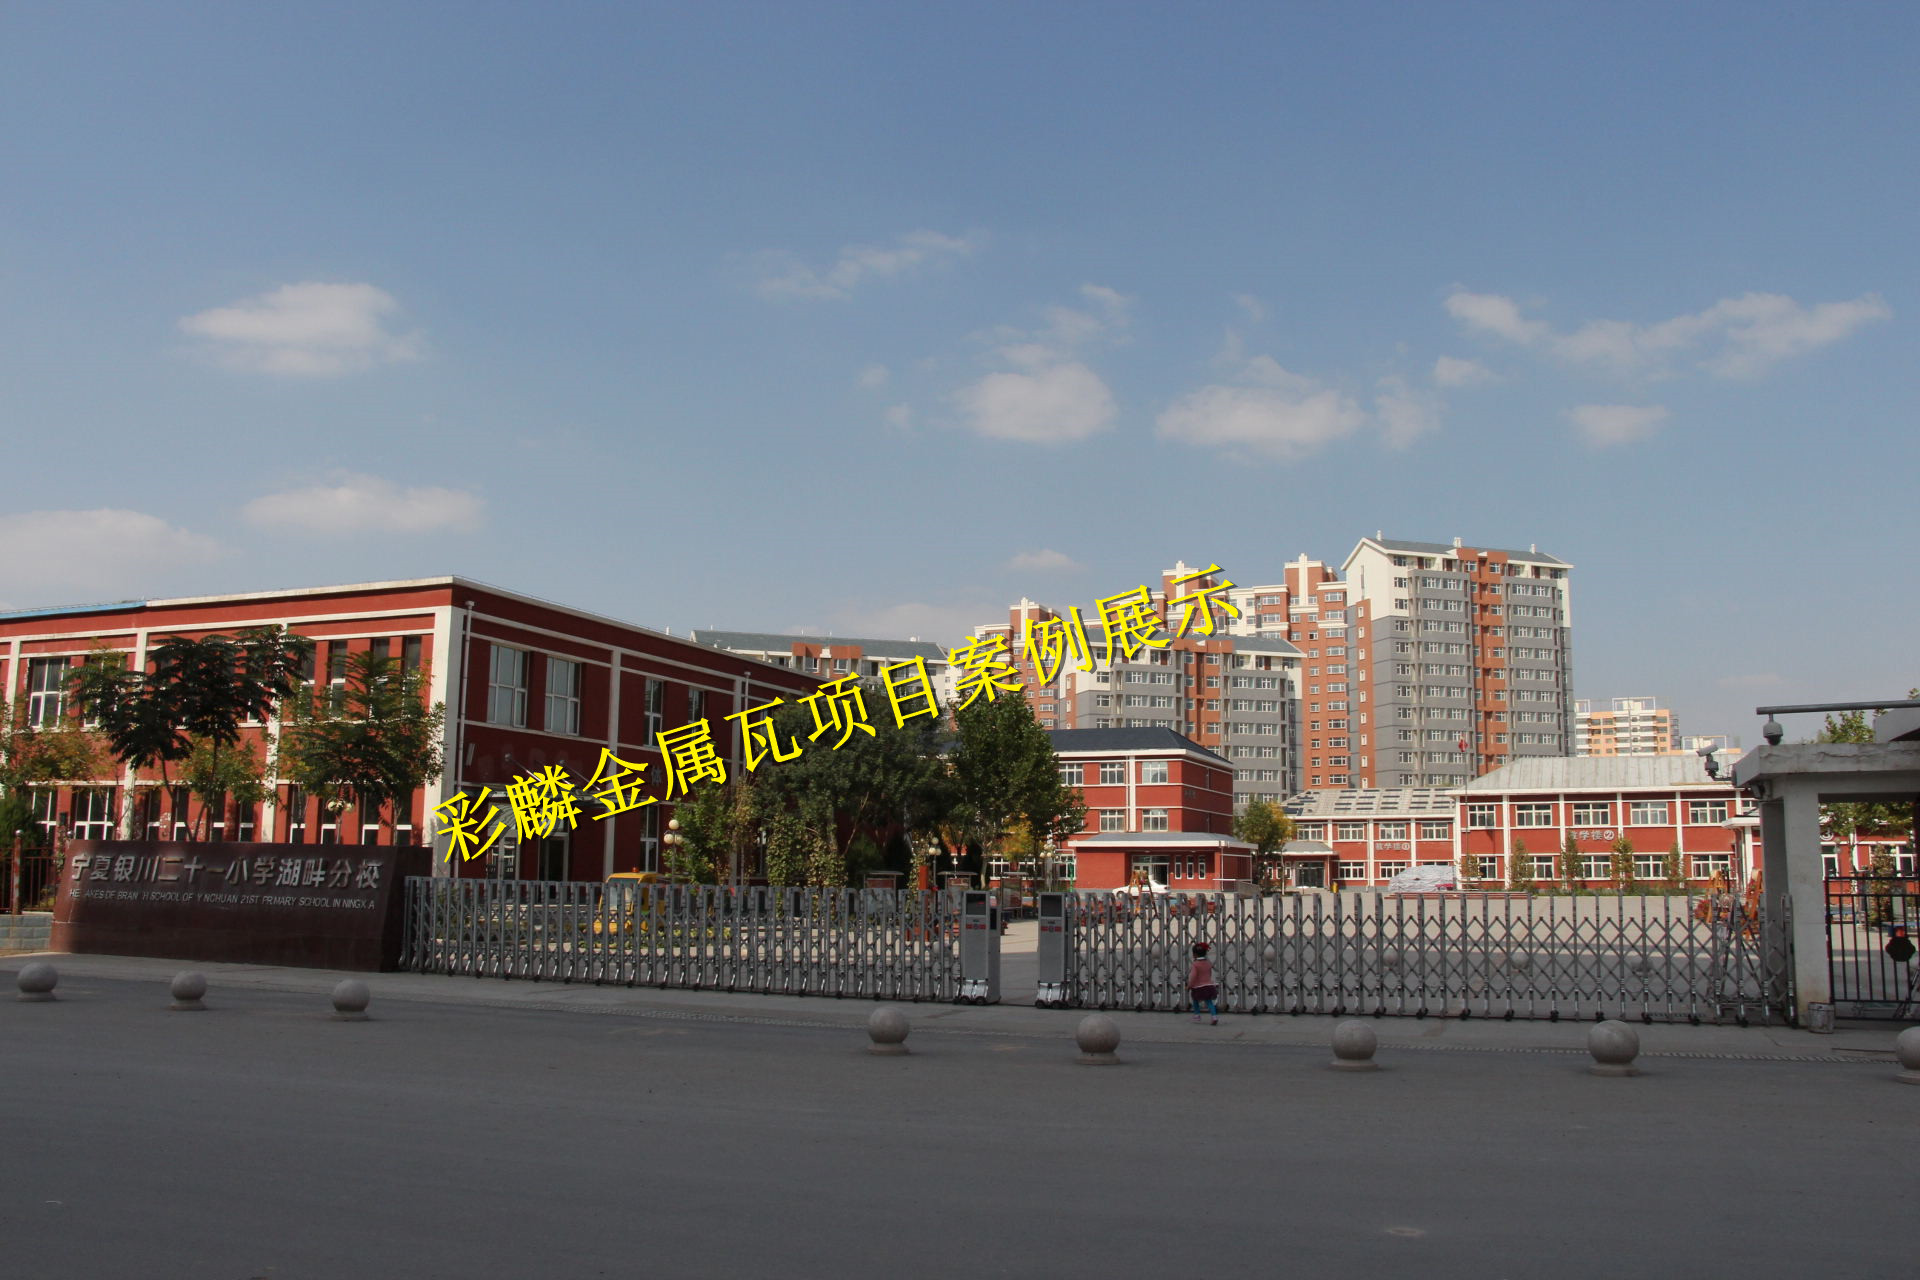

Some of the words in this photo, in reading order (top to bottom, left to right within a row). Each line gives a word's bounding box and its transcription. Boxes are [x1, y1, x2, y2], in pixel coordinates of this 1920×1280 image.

[70, 852, 383, 889] 宁夏银川二十一小学湖畔分校
[117, 890, 149, 900] BRANH
[197, 893, 239, 903] YNCHUAN
[240, 895, 259, 904] 21ST
[298, 896, 331, 908] SCHOOL
[342, 898, 375, 910] NINGXA
